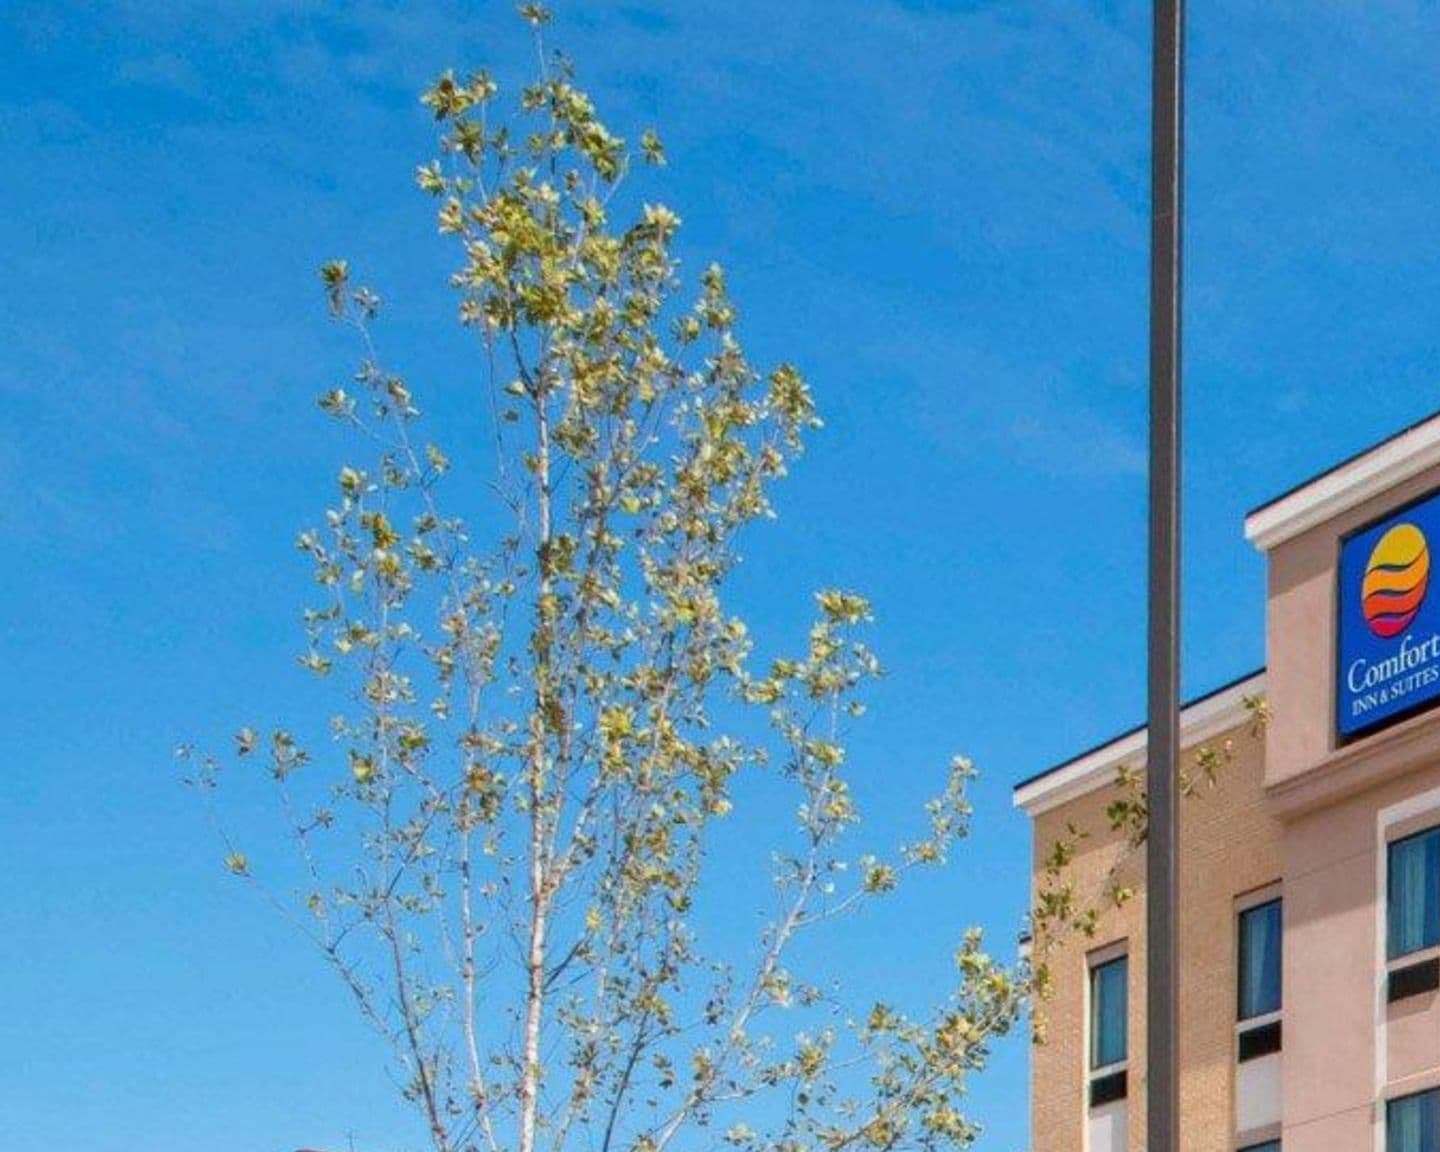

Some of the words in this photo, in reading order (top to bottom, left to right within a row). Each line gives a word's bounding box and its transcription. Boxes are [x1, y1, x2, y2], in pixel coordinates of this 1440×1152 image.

[1347, 634, 1440, 693] Comfort
[1352, 691, 1378, 716] INN
[1380, 689, 1389, 704] &
[1391, 665, 1439, 699] SUITES
